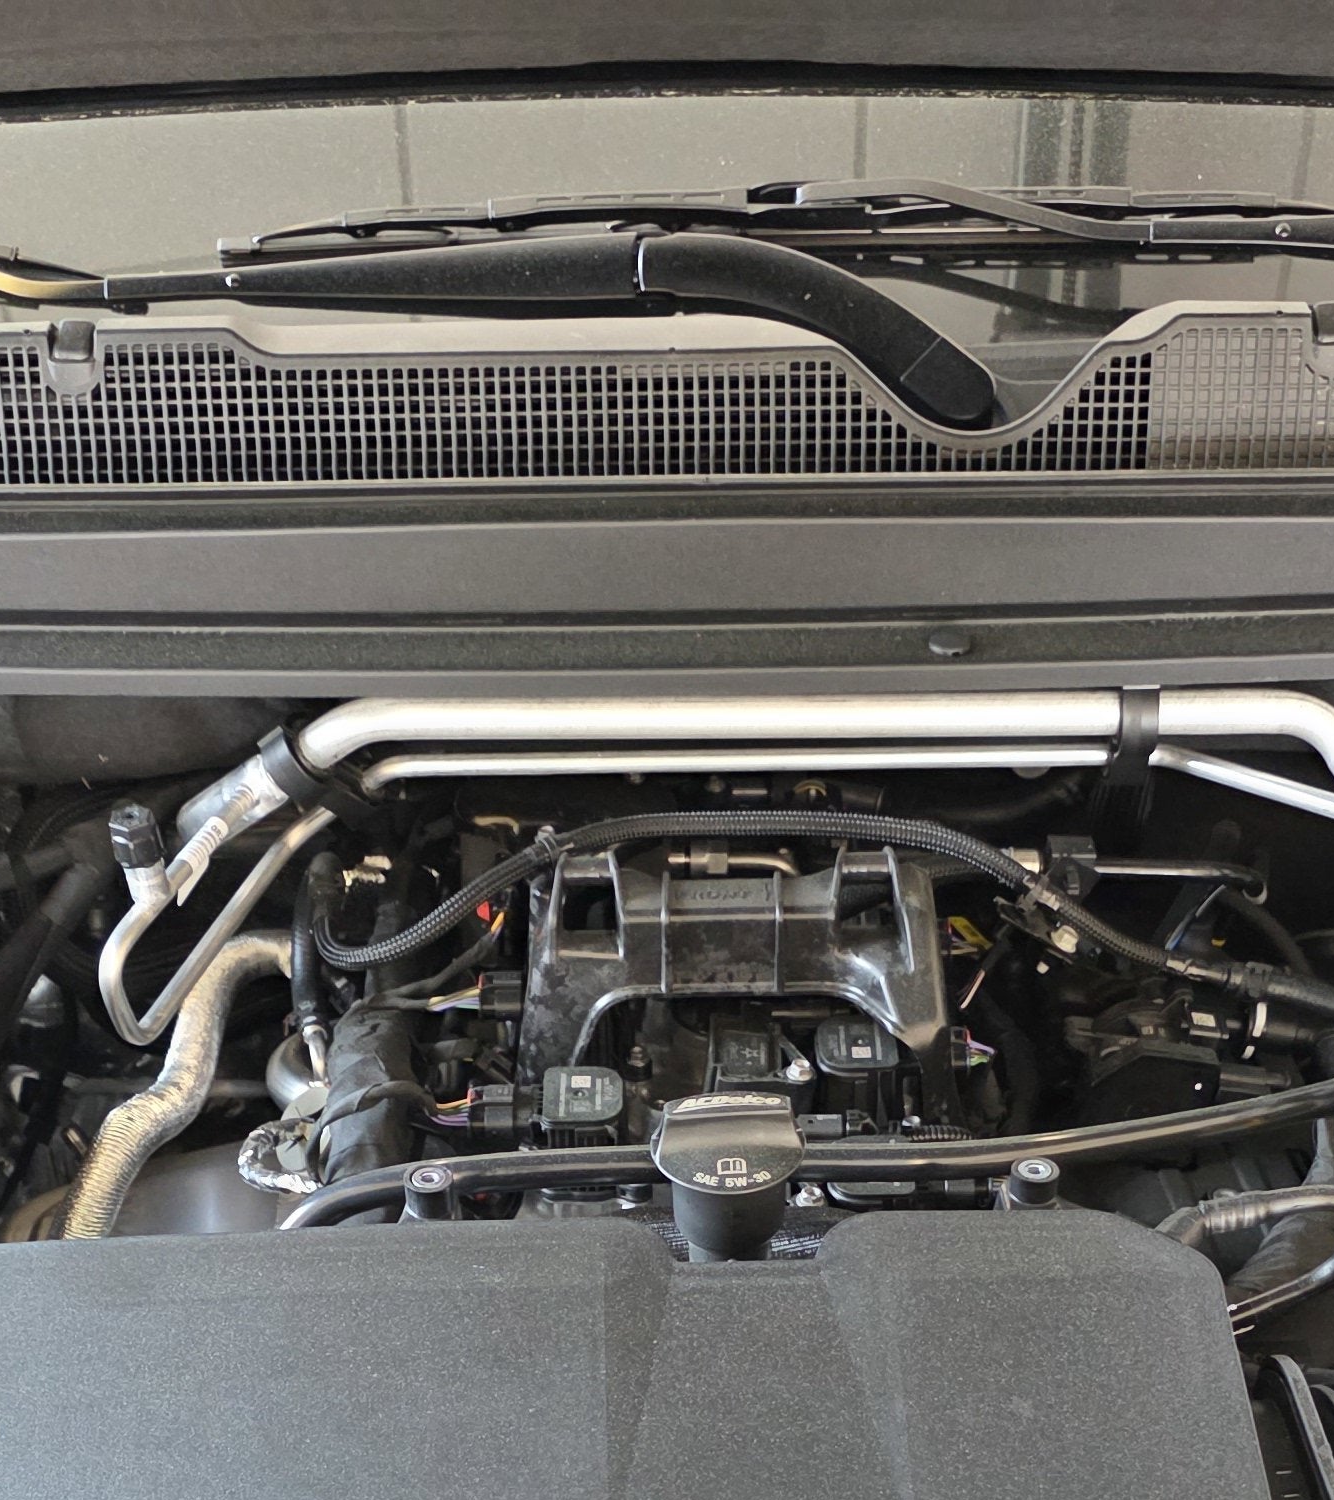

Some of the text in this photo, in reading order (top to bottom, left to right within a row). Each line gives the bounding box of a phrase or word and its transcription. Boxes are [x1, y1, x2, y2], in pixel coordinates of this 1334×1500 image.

[678, 1095, 782, 1109] ACDelco
[693, 1170, 772, 1188] SAE 5W-30
